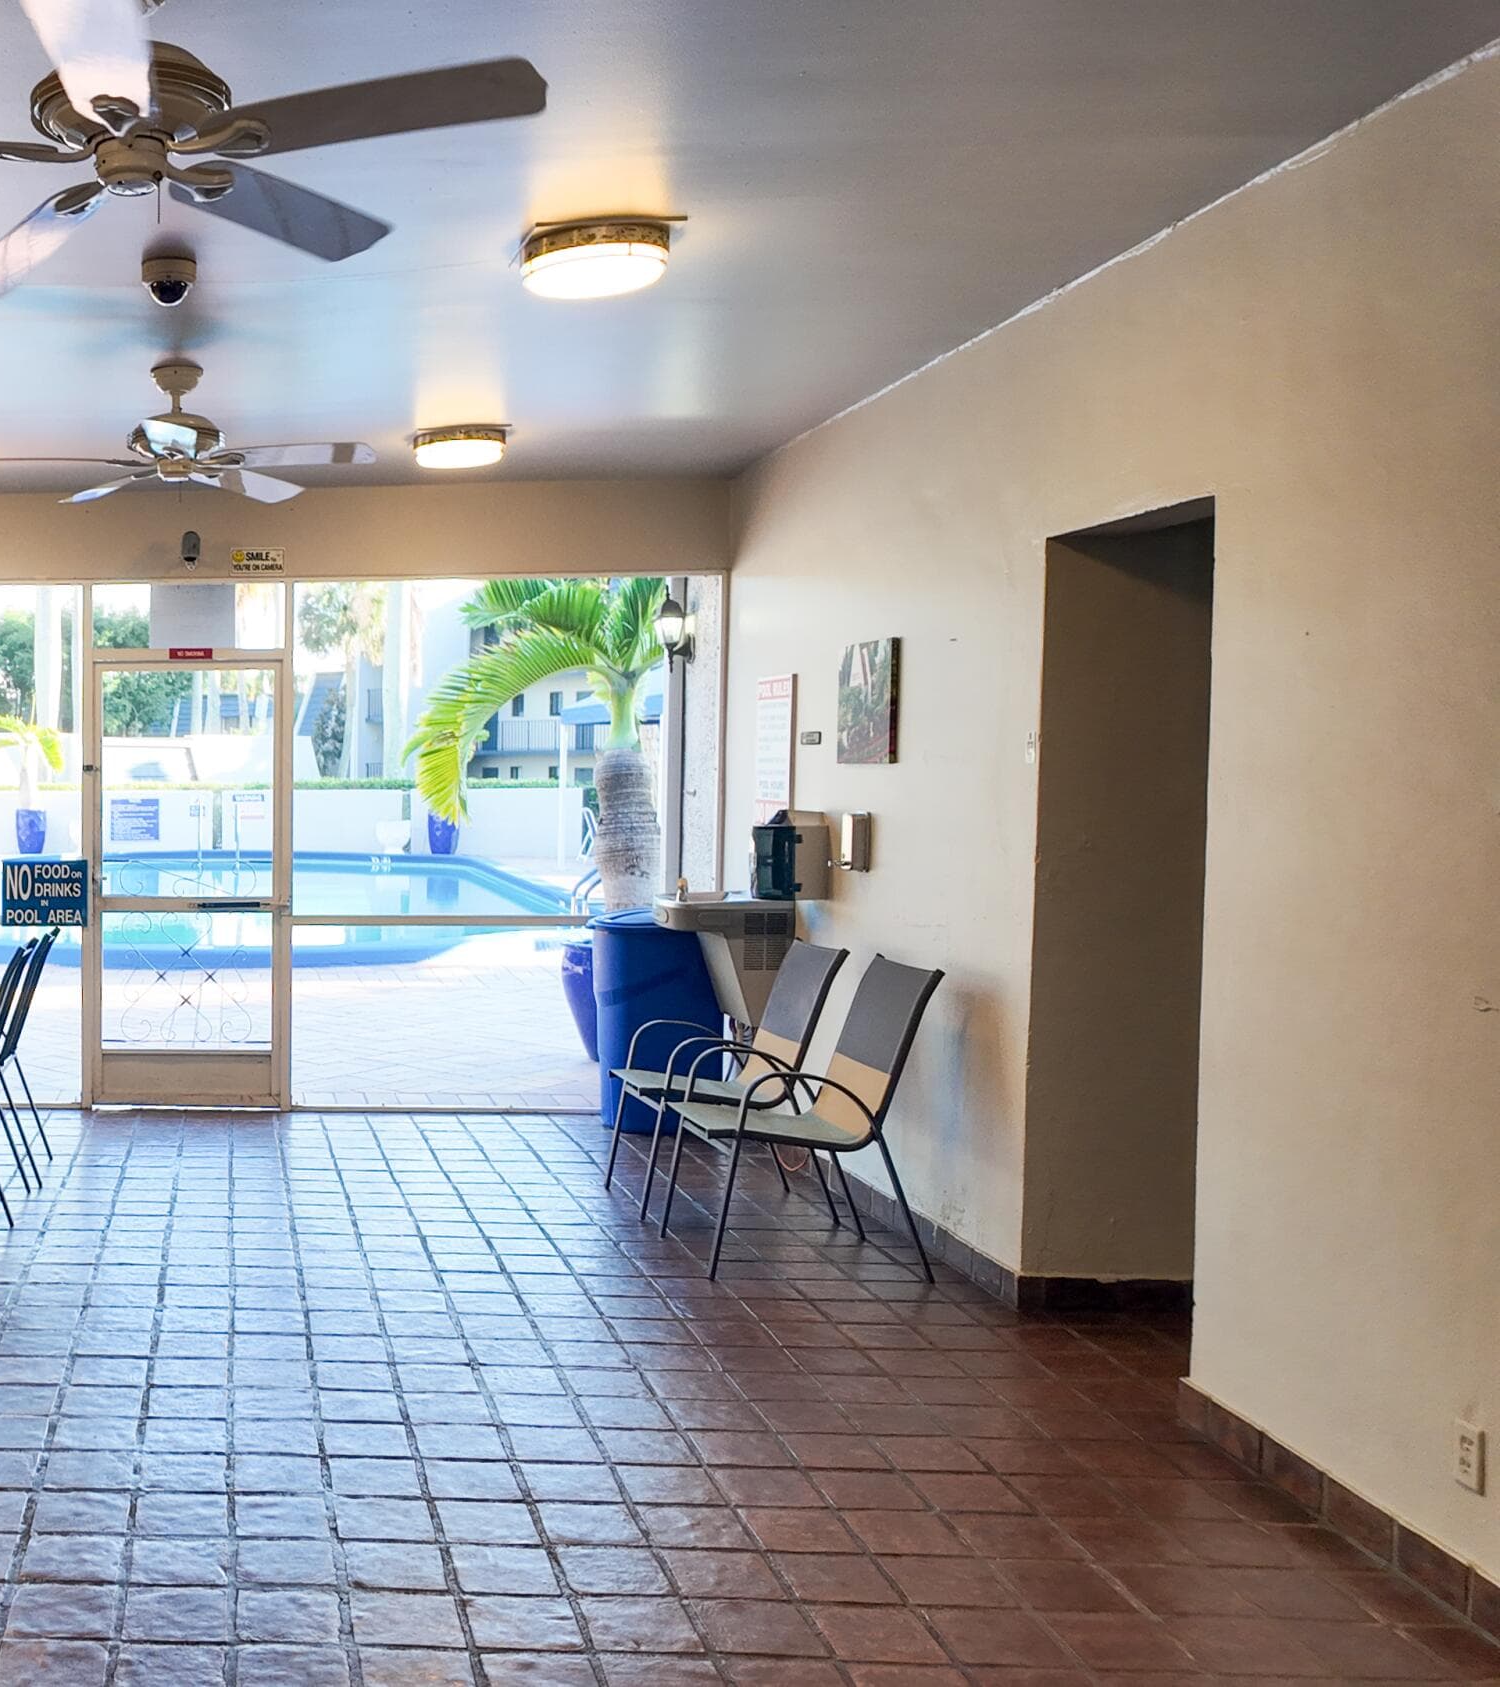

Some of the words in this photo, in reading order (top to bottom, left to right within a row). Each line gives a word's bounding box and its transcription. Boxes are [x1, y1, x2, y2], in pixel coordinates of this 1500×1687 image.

[245, 551, 270, 561] SMILE
[233, 563, 251, 571] YOU'RE
[261, 563, 283, 571] CAMERA
[6, 864, 32, 901] NO
[34, 864, 70, 879] FOOD
[71, 871, 83, 879] OR
[34, 883, 82, 898] DRINKS
[40, 899, 49, 907] IN
[6, 909, 42, 924] POOL
[47, 909, 83, 924] AREA
